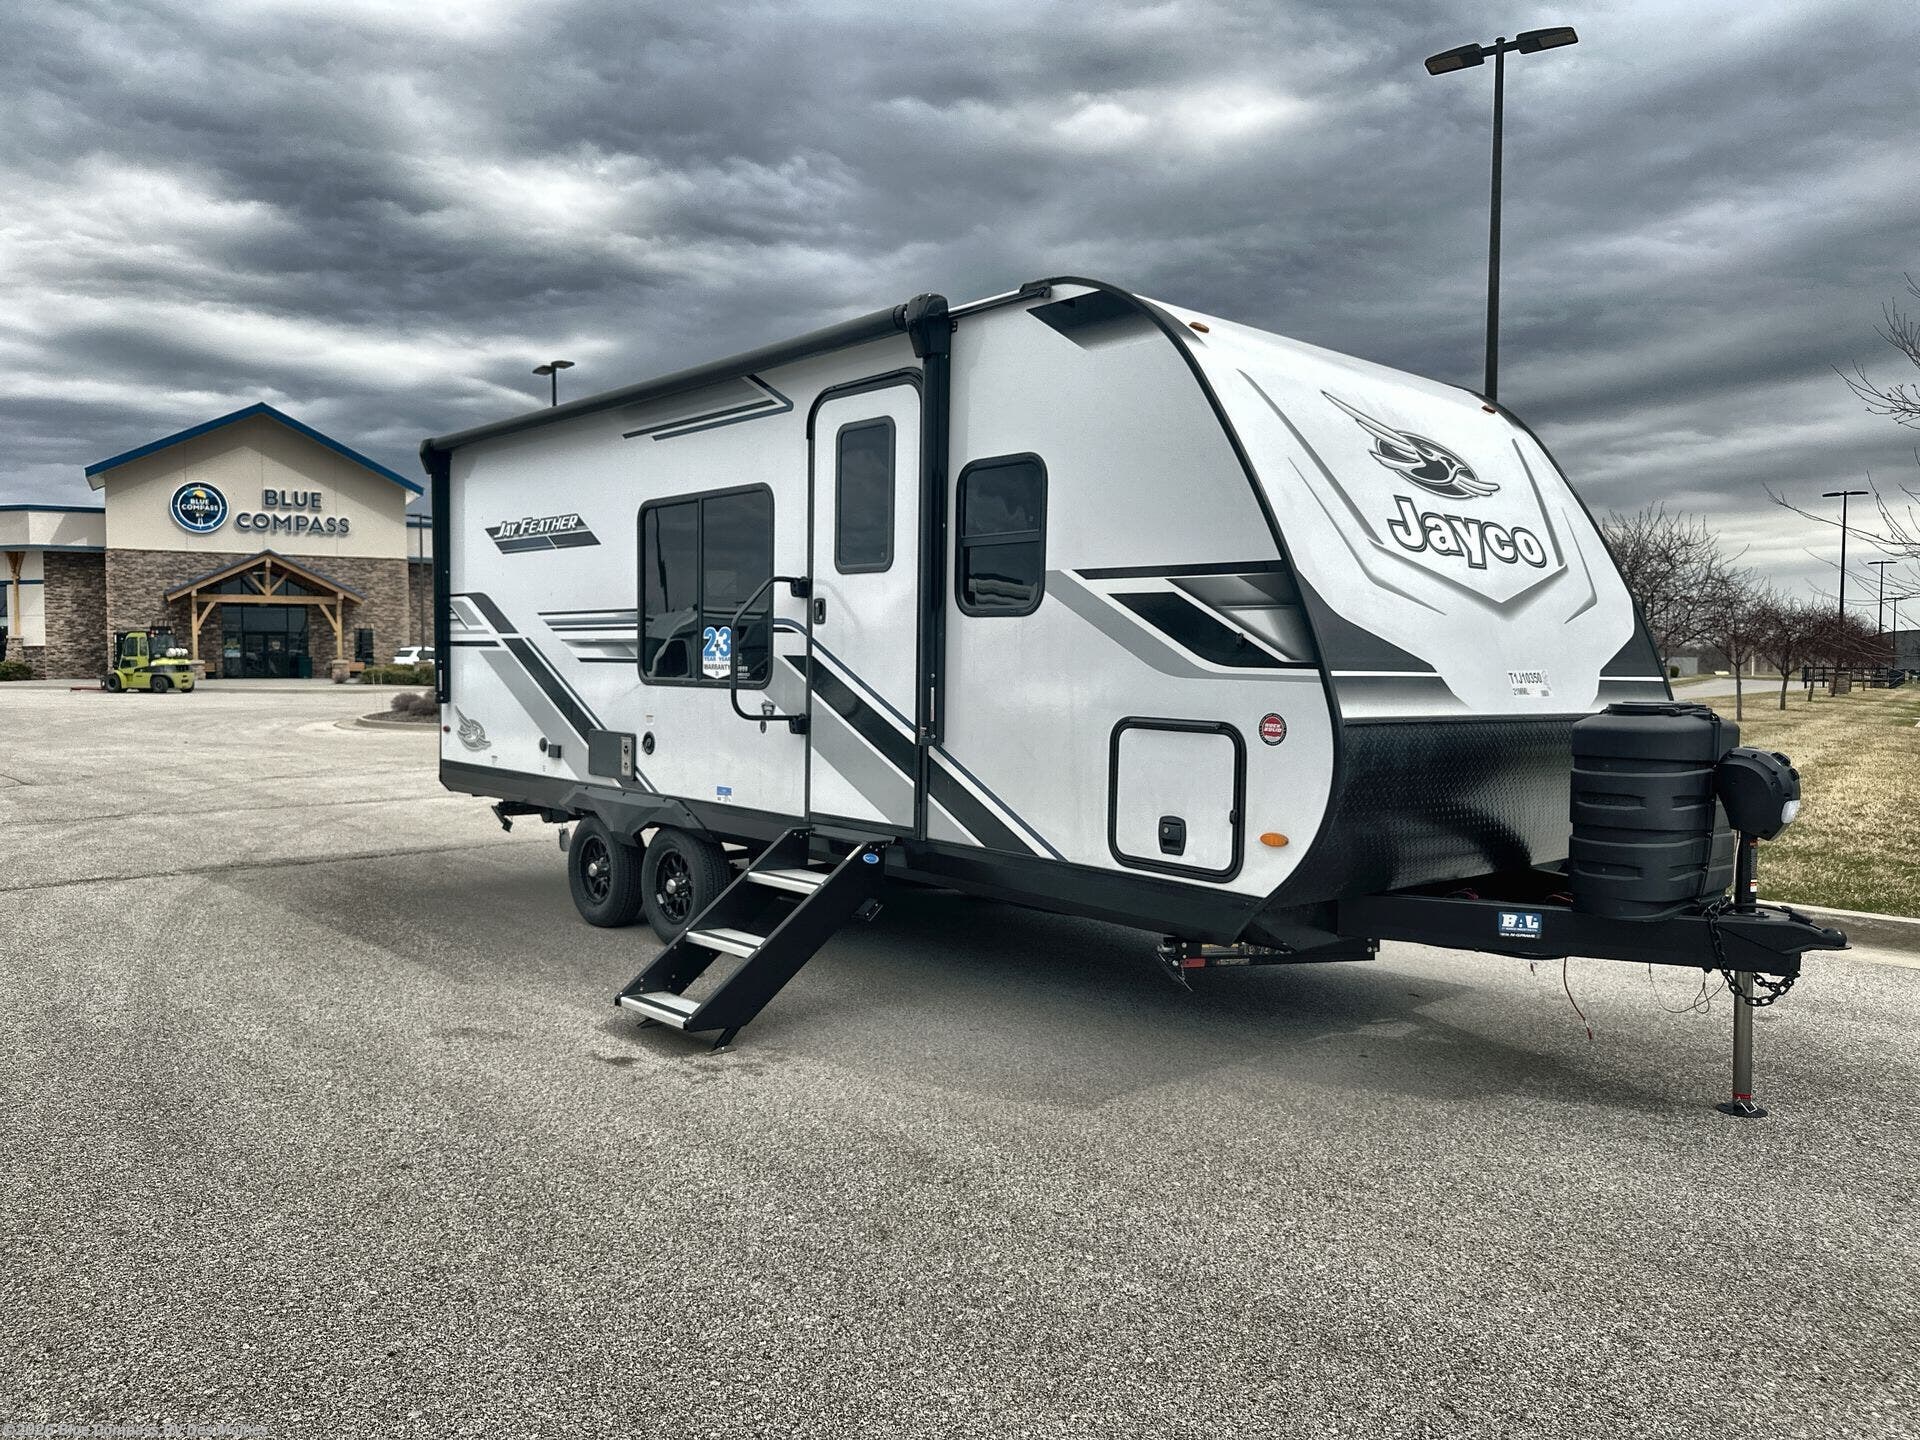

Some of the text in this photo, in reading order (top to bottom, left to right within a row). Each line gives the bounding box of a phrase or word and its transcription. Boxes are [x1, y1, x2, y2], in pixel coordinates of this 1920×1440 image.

[181, 503, 219, 511] COMPASS
[263, 489, 322, 509] BLUE
[235, 512, 351, 534] COMPASS
[493, 515, 578, 539] JAY FEATHER
[1386, 494, 1547, 570] Jayco
